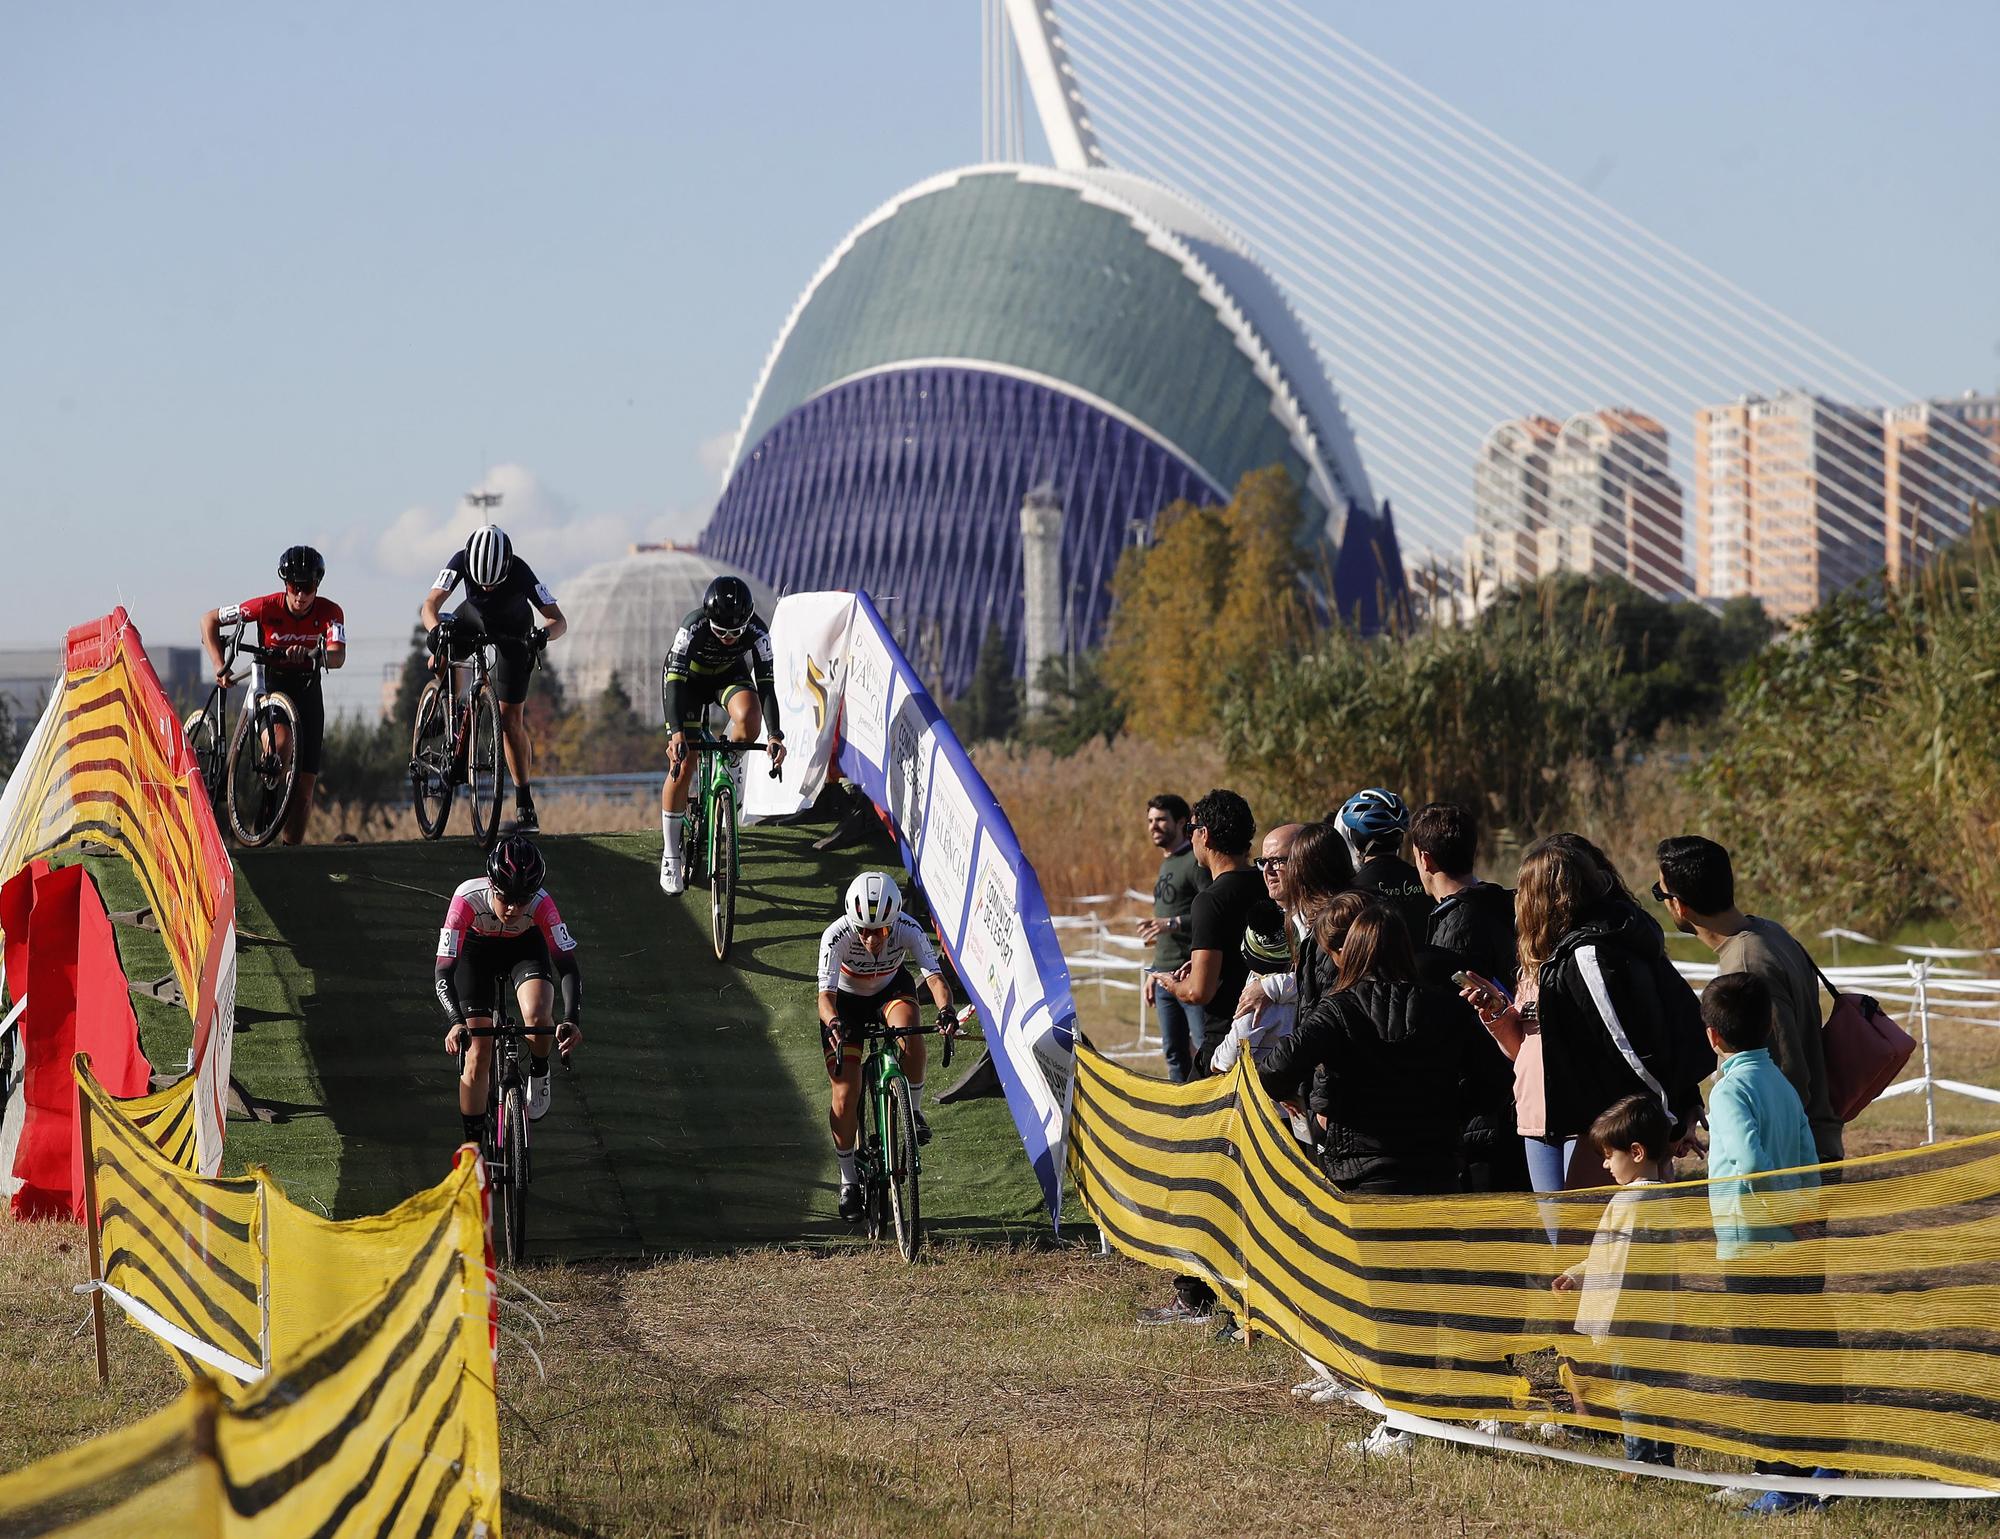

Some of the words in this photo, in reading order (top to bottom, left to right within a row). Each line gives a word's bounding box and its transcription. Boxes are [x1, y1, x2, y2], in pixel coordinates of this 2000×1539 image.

[762, 638, 770, 652] 2
[444, 931, 450, 947] 3
[560, 926, 568, 941] 3
[823, 952, 829, 968] 1
